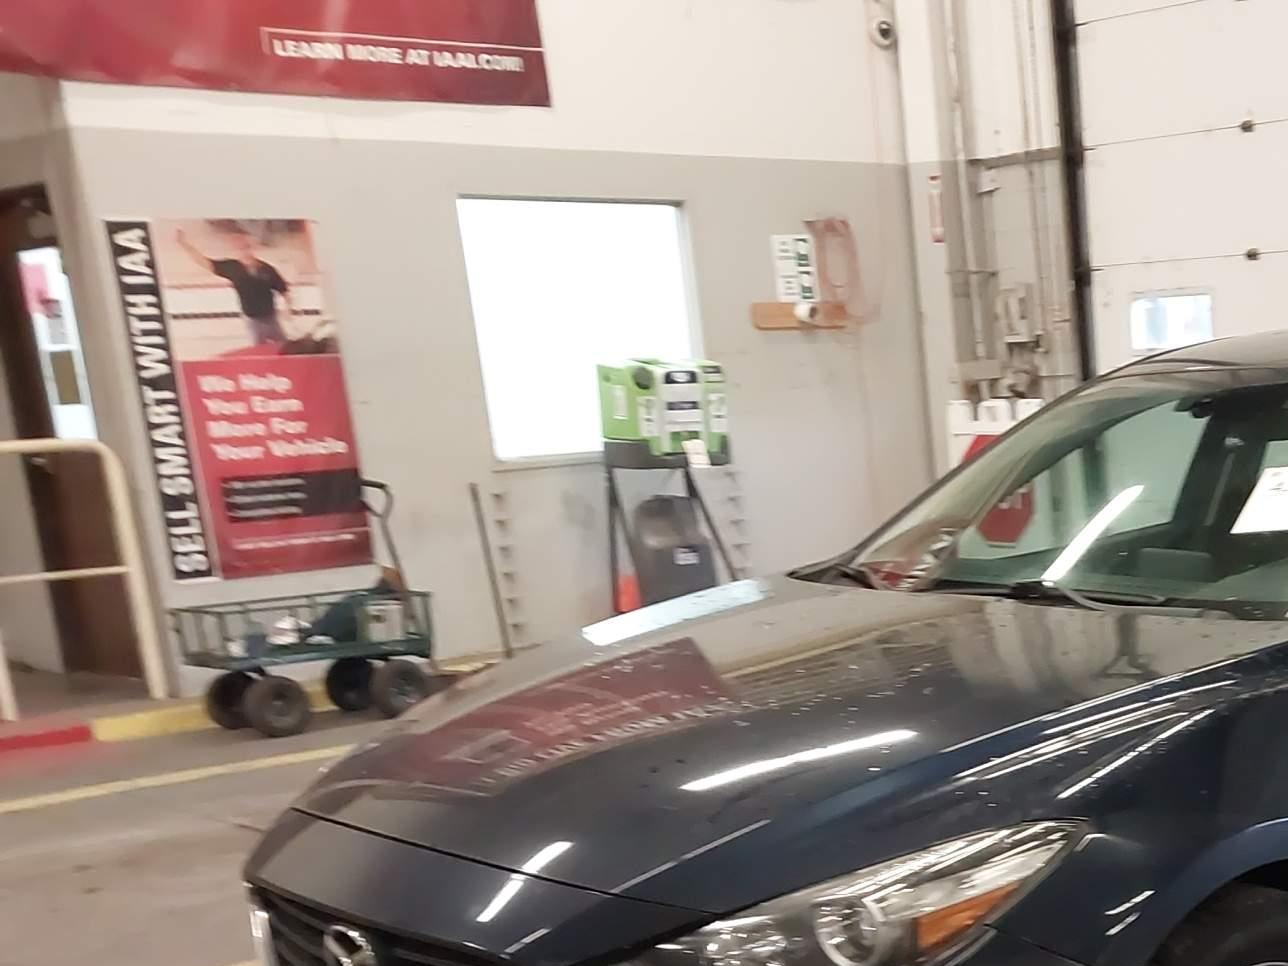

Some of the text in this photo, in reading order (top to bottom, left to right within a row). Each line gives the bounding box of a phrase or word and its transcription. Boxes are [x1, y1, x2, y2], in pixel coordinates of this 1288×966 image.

[272, 39, 344, 60] LEARN
[346, 43, 404, 65] MORE
[405, 48, 431, 66] AT
[112, 228, 209, 572] SELL SMART WITH IAA
